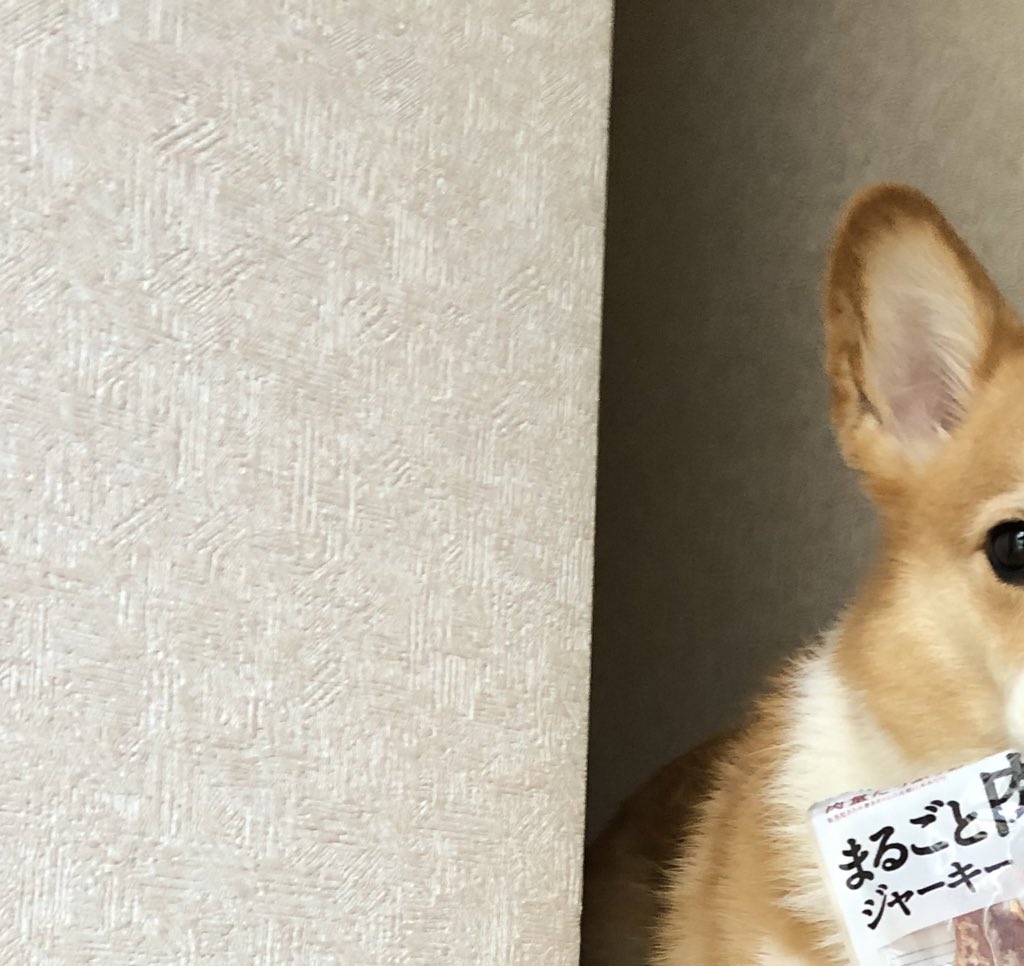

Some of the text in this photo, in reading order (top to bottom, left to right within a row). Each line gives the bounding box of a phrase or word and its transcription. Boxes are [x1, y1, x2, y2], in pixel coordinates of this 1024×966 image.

[862, 860, 1014, 930] ジャーキー
